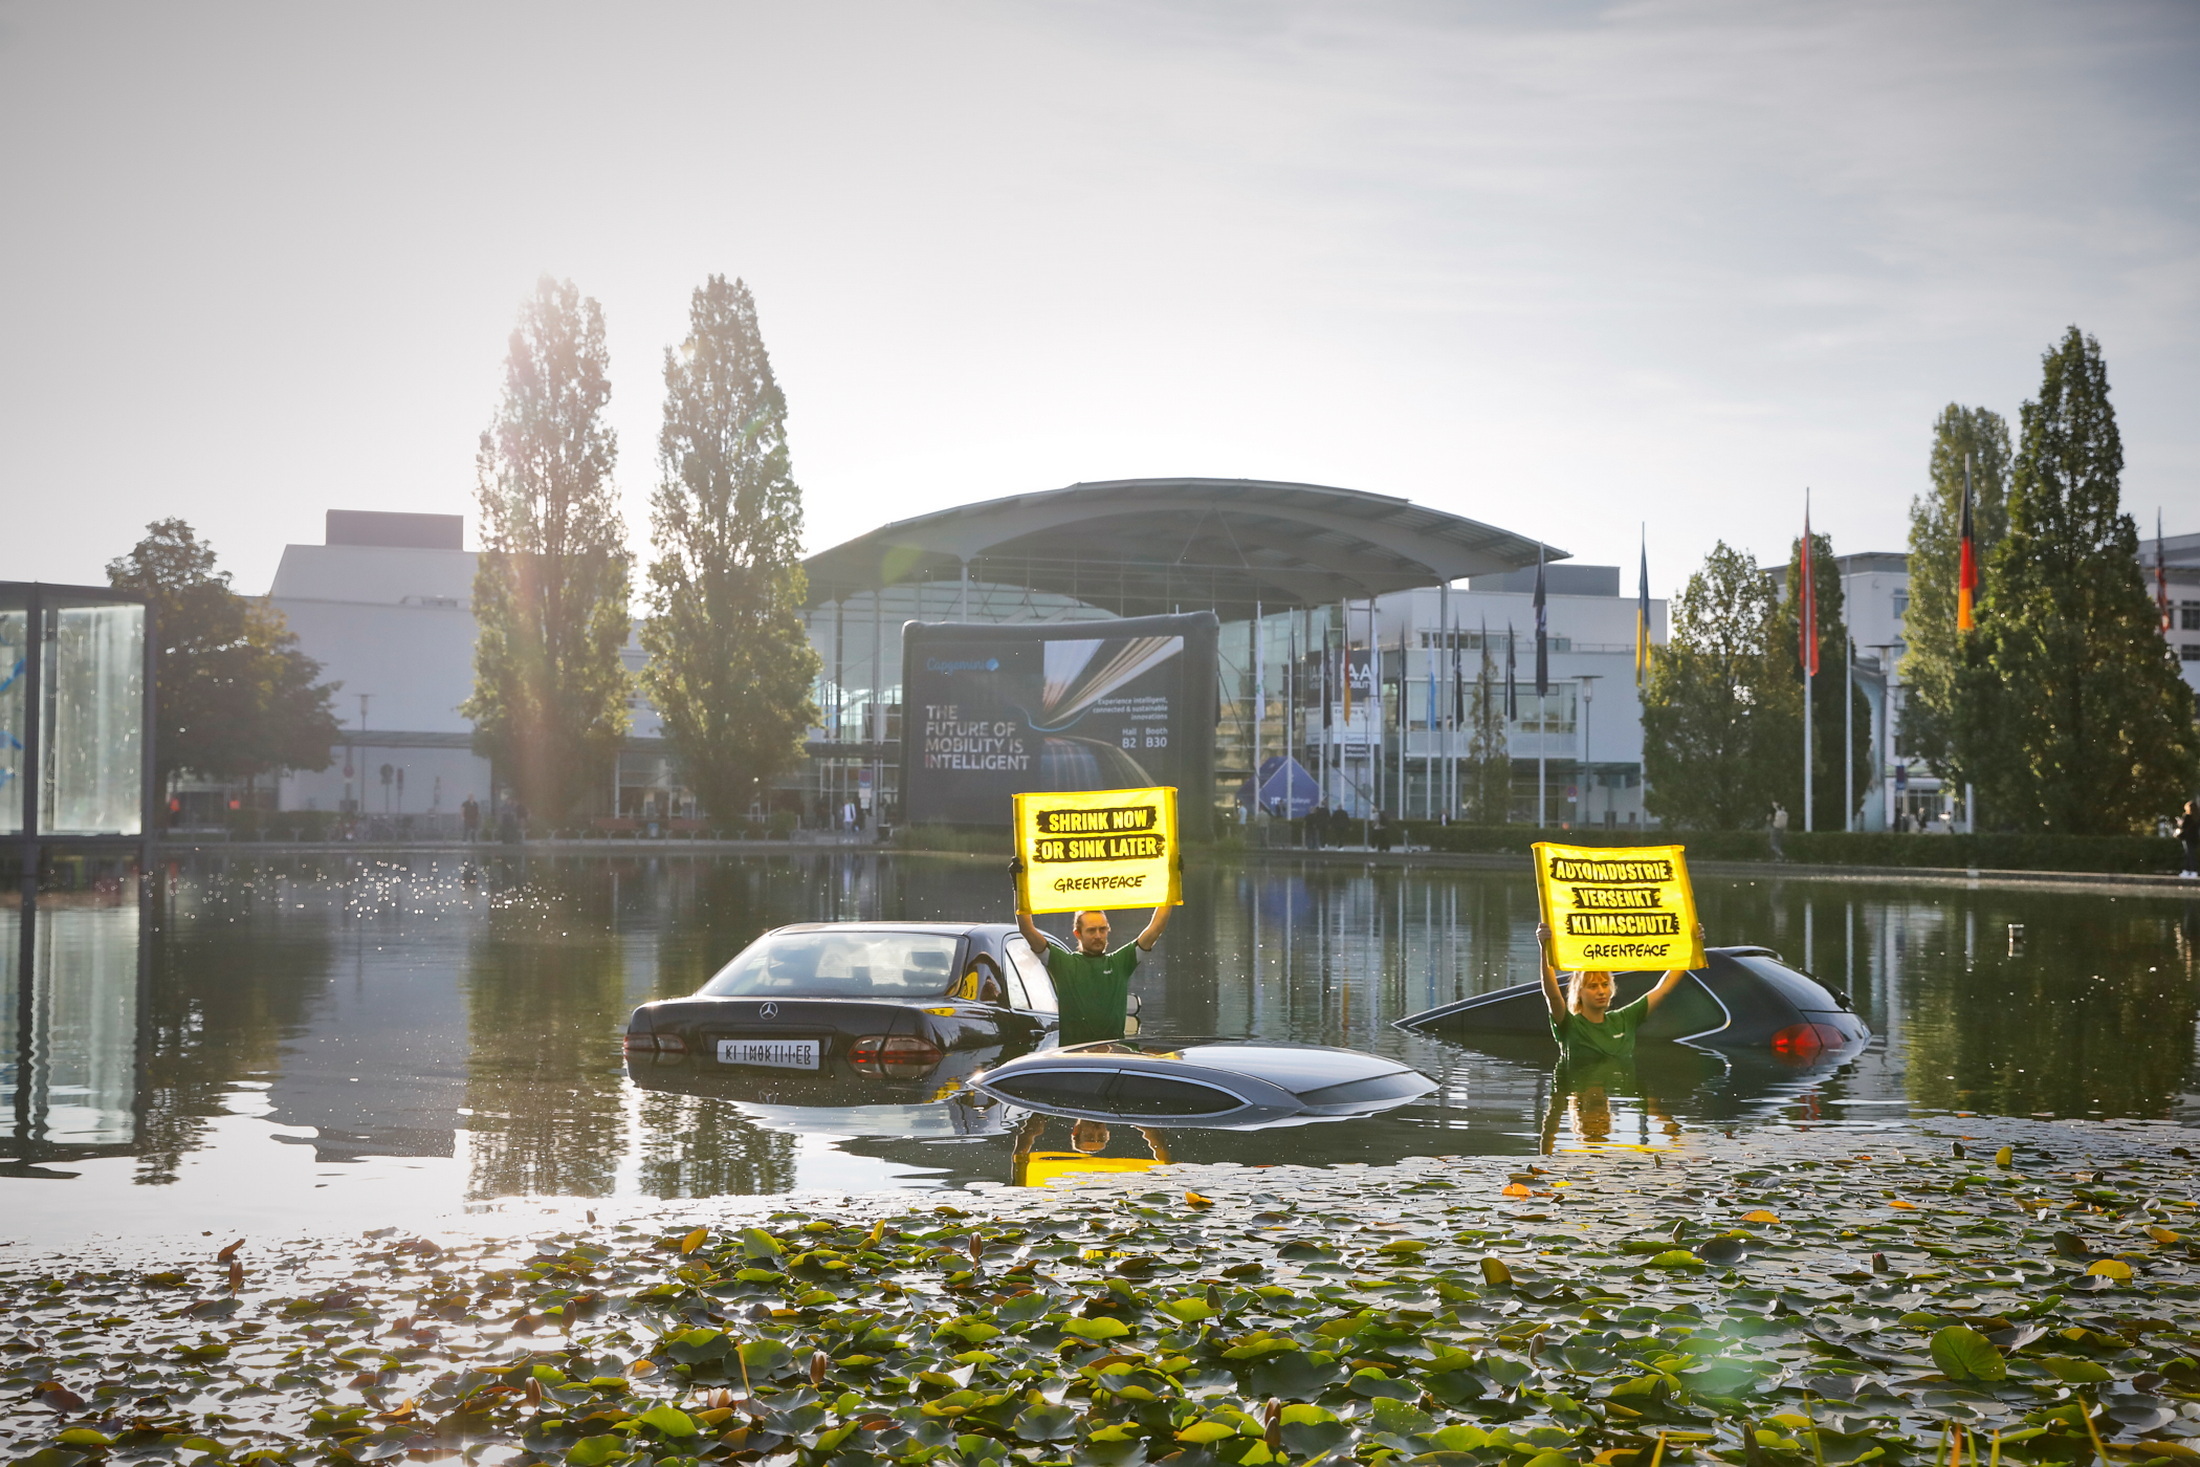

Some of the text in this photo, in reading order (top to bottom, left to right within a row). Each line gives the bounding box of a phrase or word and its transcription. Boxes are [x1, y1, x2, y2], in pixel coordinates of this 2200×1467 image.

[926, 657, 985, 676] Capgemini
[926, 704, 958, 720] THE
[1126, 705, 1131, 713] &
[1132, 704, 1168, 712] sustainable
[926, 721, 1017, 737] FUTURE OF
[1122, 727, 1137, 735] Hall
[1145, 727, 1168, 735] Booth
[925, 738, 1024, 754] MOBILITY IS
[1122, 737, 1136, 749] B2
[1145, 736, 1167, 748] B30
[925, 754, 1031, 770] INTELLIGENT
[1049, 809, 1148, 832] SHRINK NOW
[1041, 836, 1157, 860] OR SINK LATER
[1556, 860, 1670, 881] AUTOINDUSTRIE
[1054, 875, 1147, 893] GREENPEACE
[1579, 889, 1652, 907] VERSENKT
[1571, 914, 1674, 934] KLIMASCHUTZ
[1583, 943, 1671, 960] GREENPEACE
